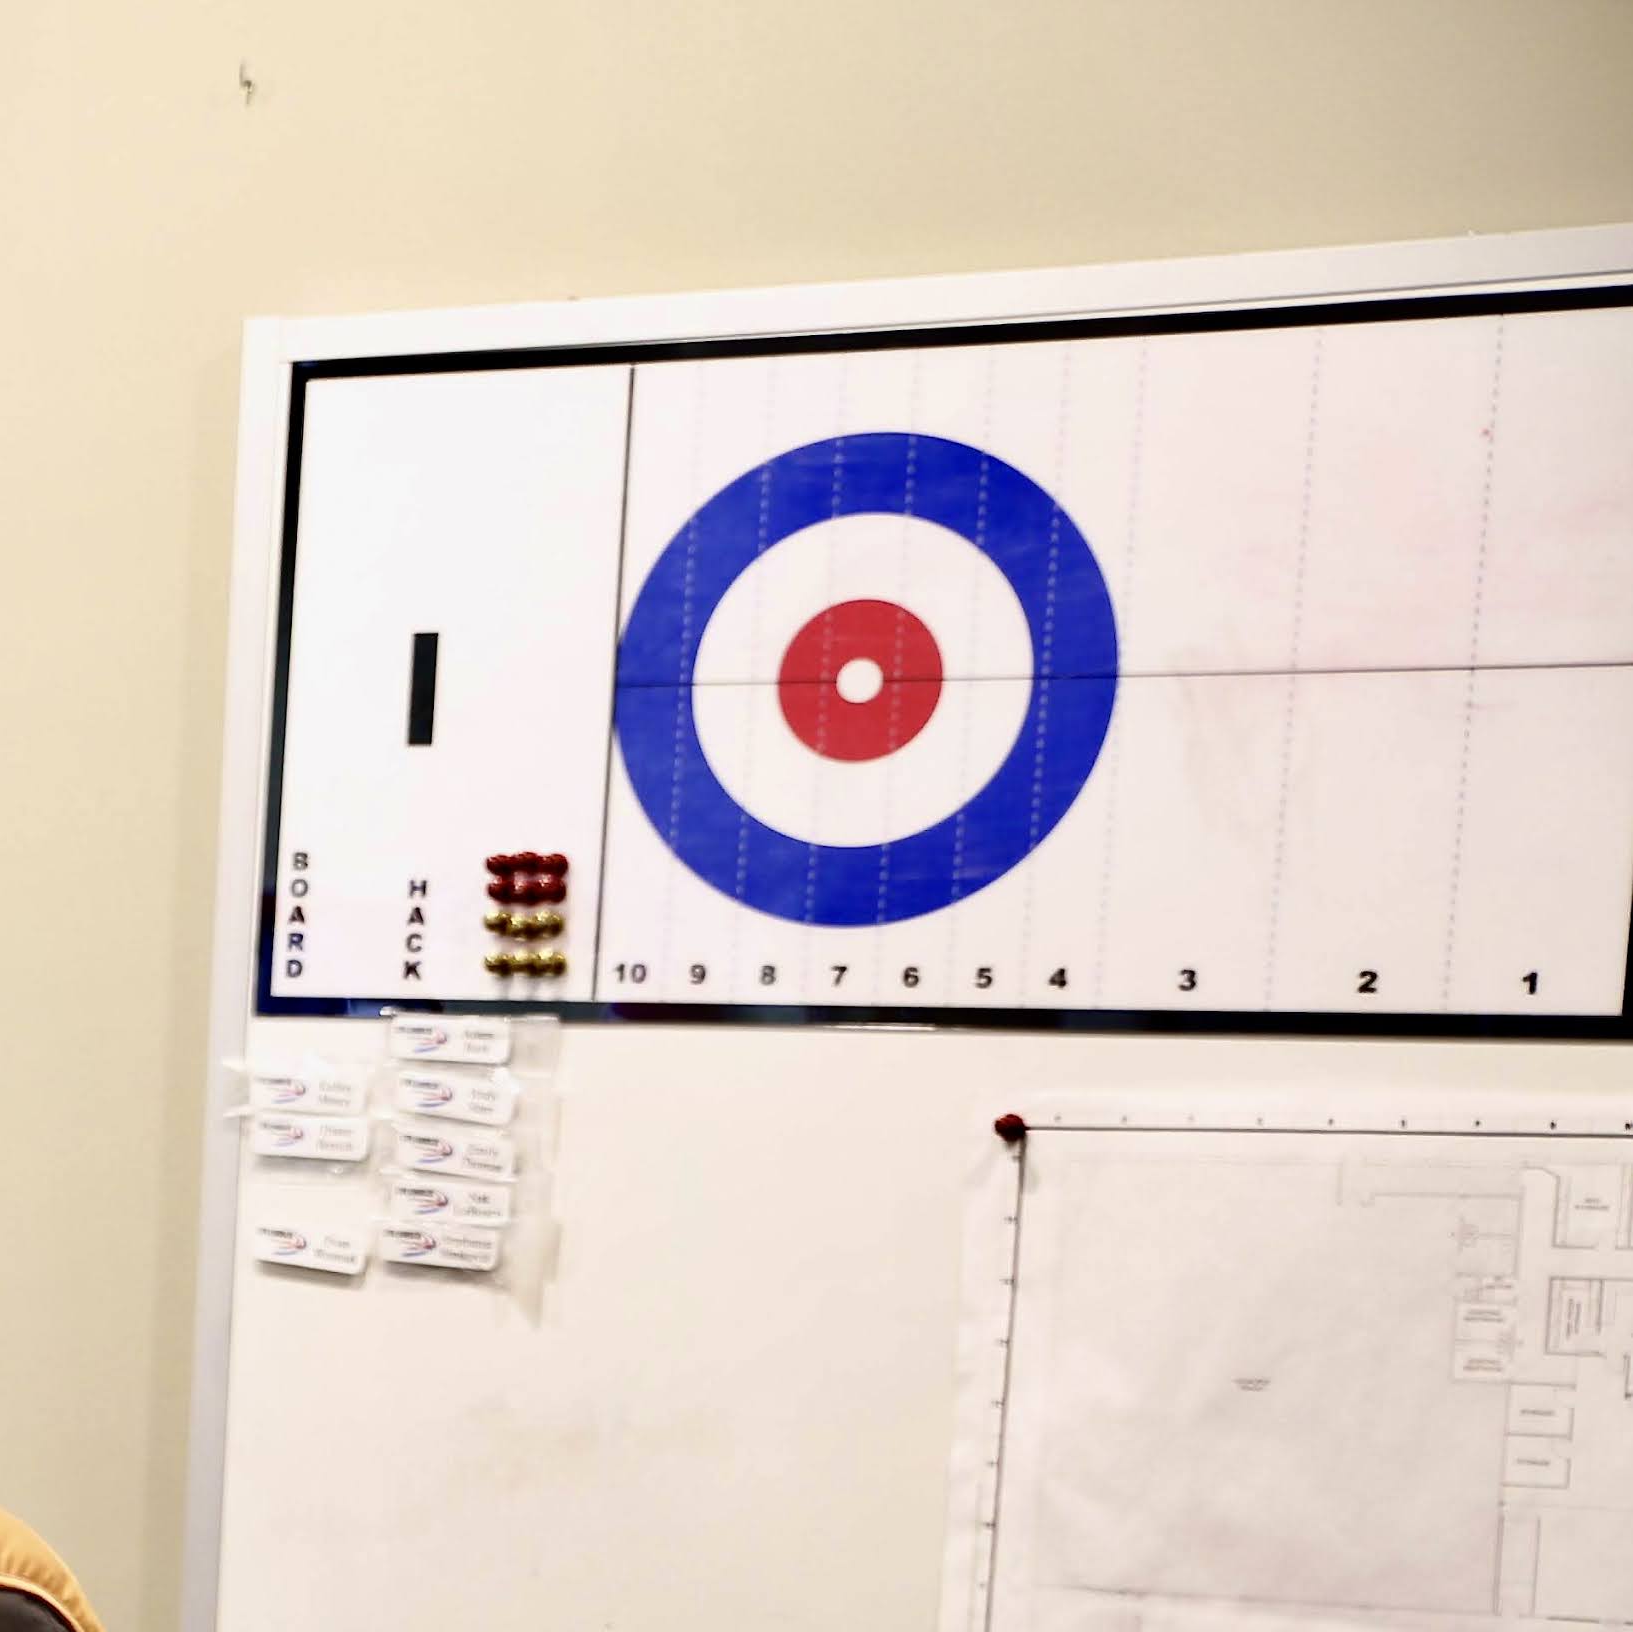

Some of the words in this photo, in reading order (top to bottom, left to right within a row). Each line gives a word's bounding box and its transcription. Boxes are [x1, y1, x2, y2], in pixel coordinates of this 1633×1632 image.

[286, 851, 309, 979] BOARD
[403, 879, 428, 981] HACK
[615, 963, 647, 983] 10
[689, 964, 707, 985] 9
[759, 965, 777, 986] 8
[830, 965, 848, 986] 7
[903, 967, 920, 988] 6
[975, 967, 993, 989] 5
[1047, 967, 1068, 989] 4
[1177, 969, 1197, 991] 3
[1358, 970, 1378, 993] 2
[1521, 972, 1539, 995] 1
